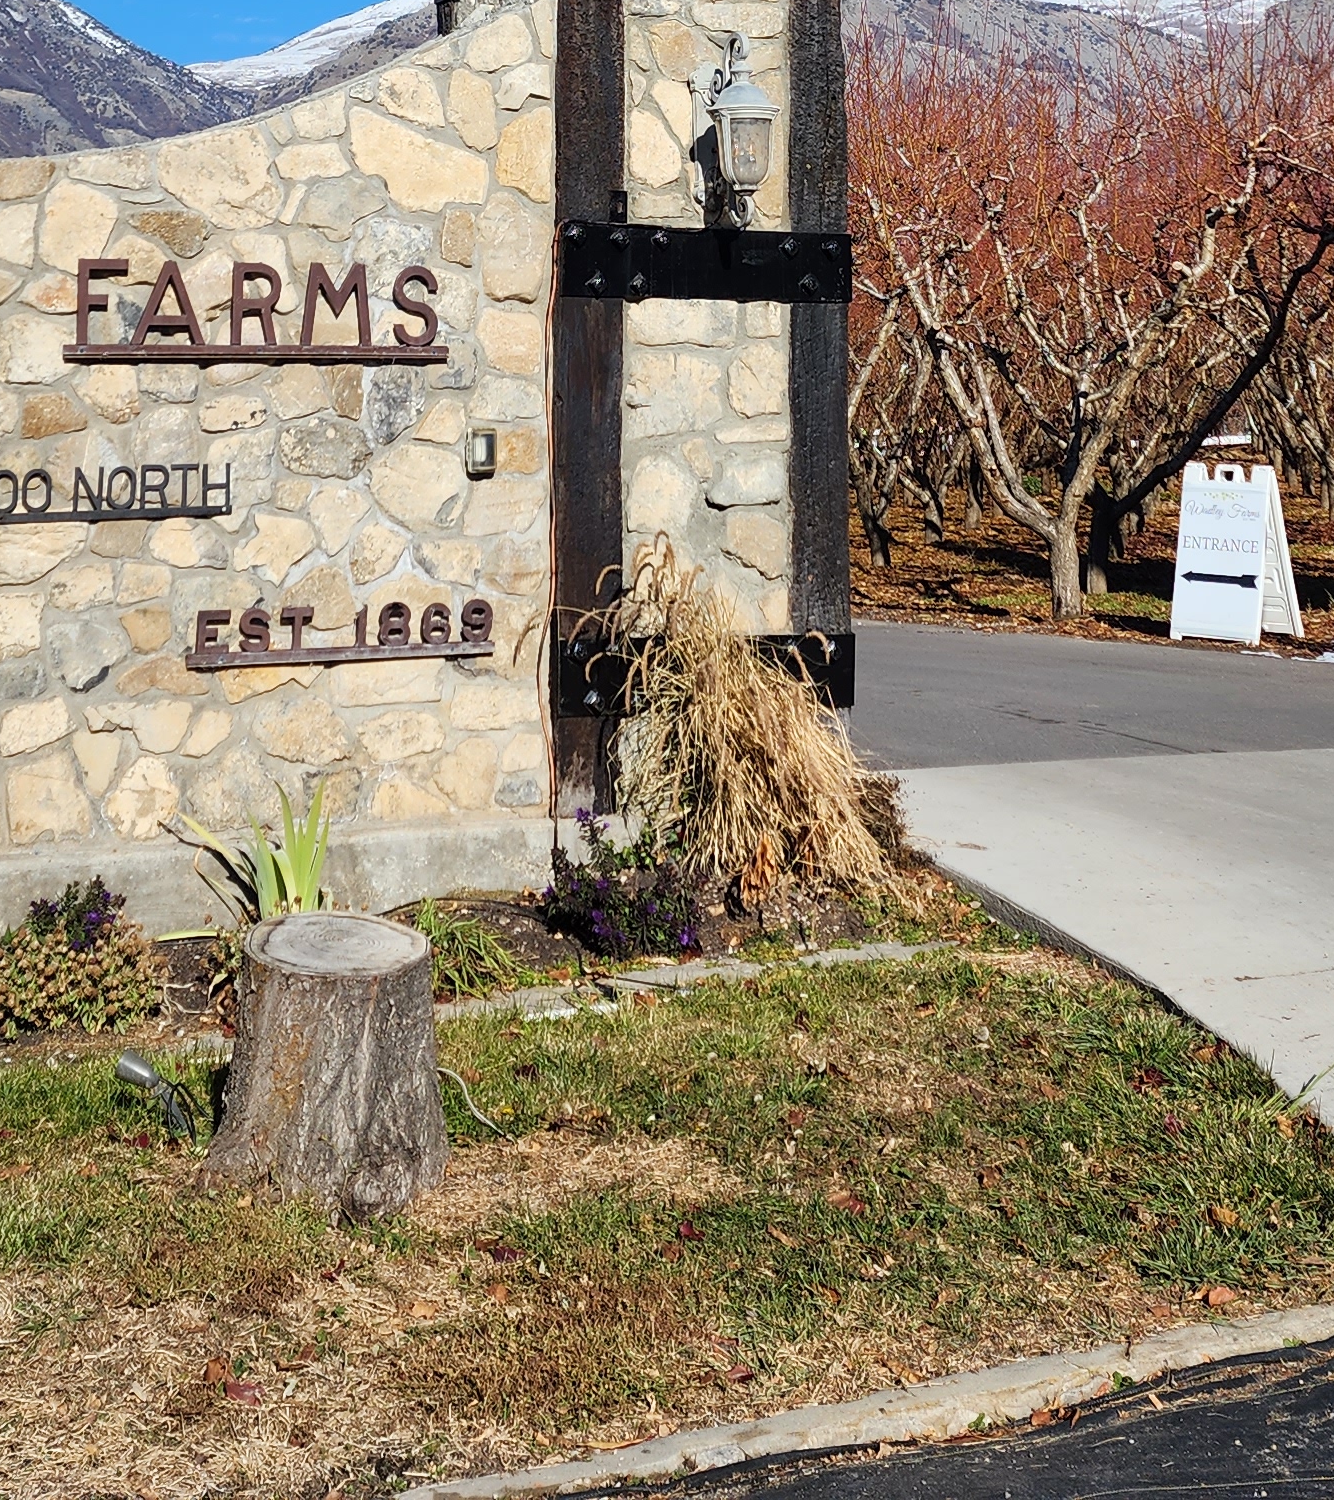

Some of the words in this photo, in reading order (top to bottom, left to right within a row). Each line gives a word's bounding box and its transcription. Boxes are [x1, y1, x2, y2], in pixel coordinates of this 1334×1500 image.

[75, 257, 440, 347] FARMS
[72, 463, 232, 512] NORTH
[1182, 535, 1259, 554] ENTRANCE
[194, 605, 315, 655] EST
[354, 599, 493, 647] 1869
